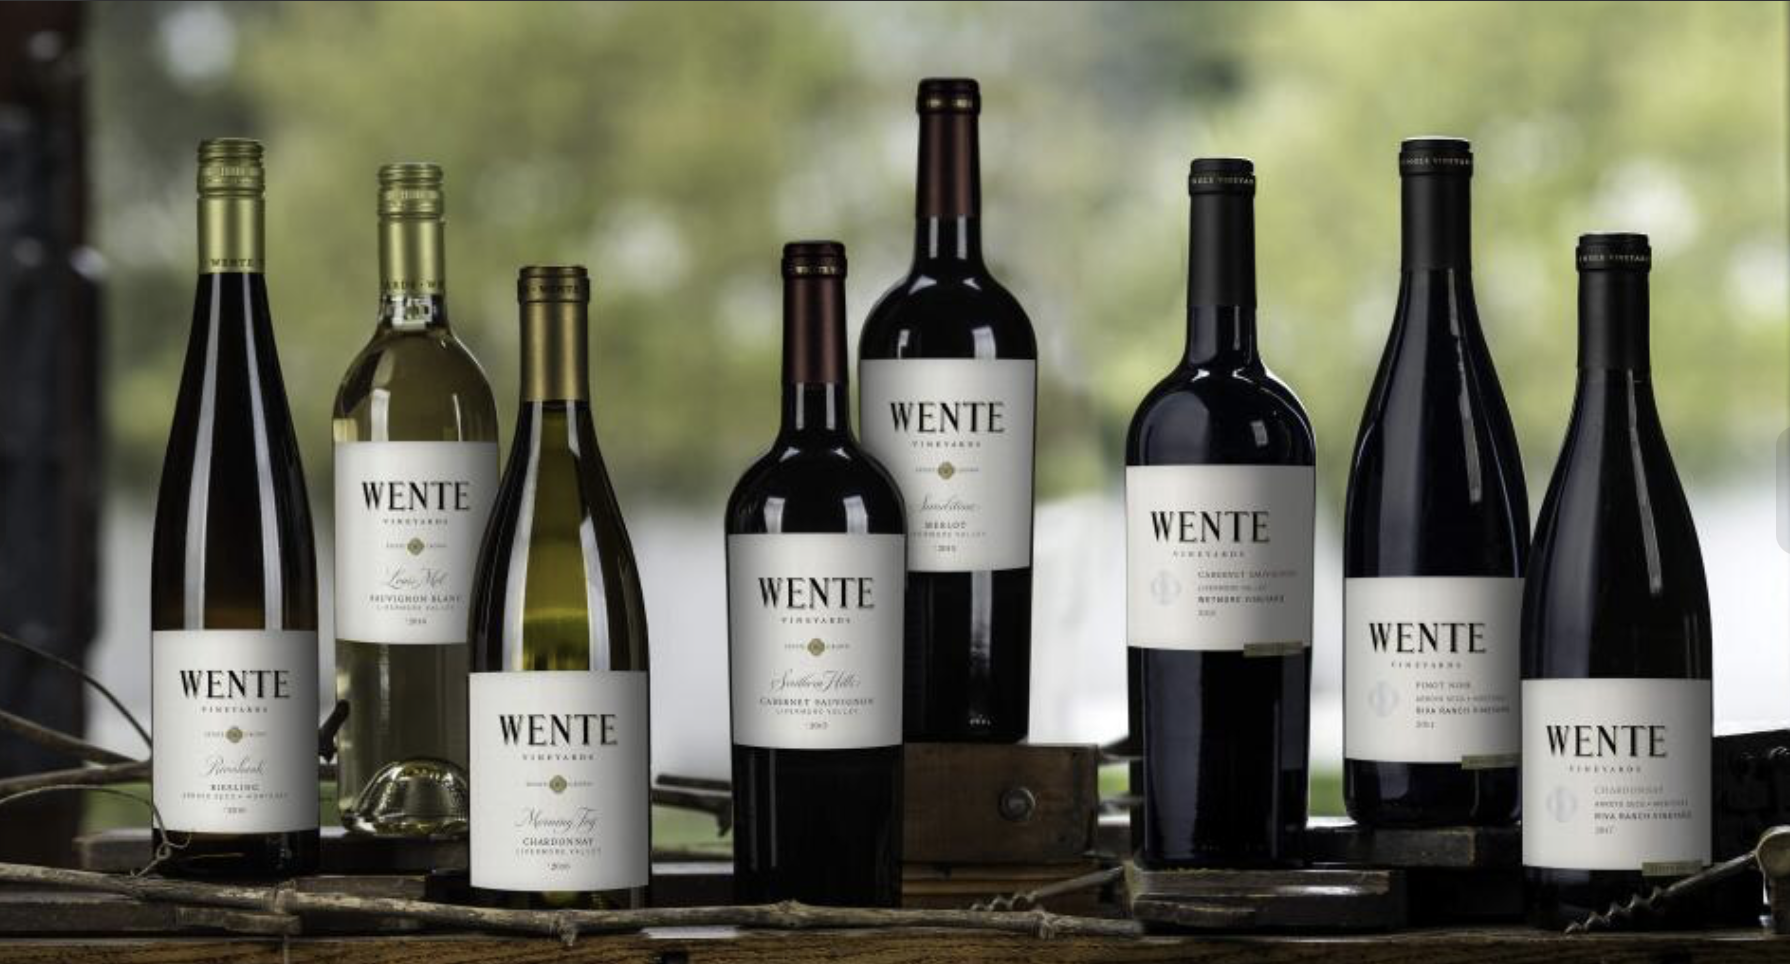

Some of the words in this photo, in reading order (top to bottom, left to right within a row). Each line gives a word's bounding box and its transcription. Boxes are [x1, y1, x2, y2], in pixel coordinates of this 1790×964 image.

[890, 401, 1005, 434] WENTE
[912, 440, 981, 448] VINEYARDS
[361, 481, 471, 511] WENTE
[924, 521, 967, 530] MERLOT
[1151, 510, 1271, 543] WENTE
[758, 576, 876, 611] WENTE
[781, 617, 852, 625] VINEYARDS
[1369, 622, 1487, 654] WENTE
[179, 669, 291, 699] WENTE
[201, 705, 268, 714] VINEYARDS
[759, 697, 811, 707] CABERNET
[498, 713, 619, 747] WENTE
[1546, 724, 1669, 758] WENTE
[1568, 765, 1642, 773] VINEYARDS
[522, 837, 594, 847] CHARDONNAY
